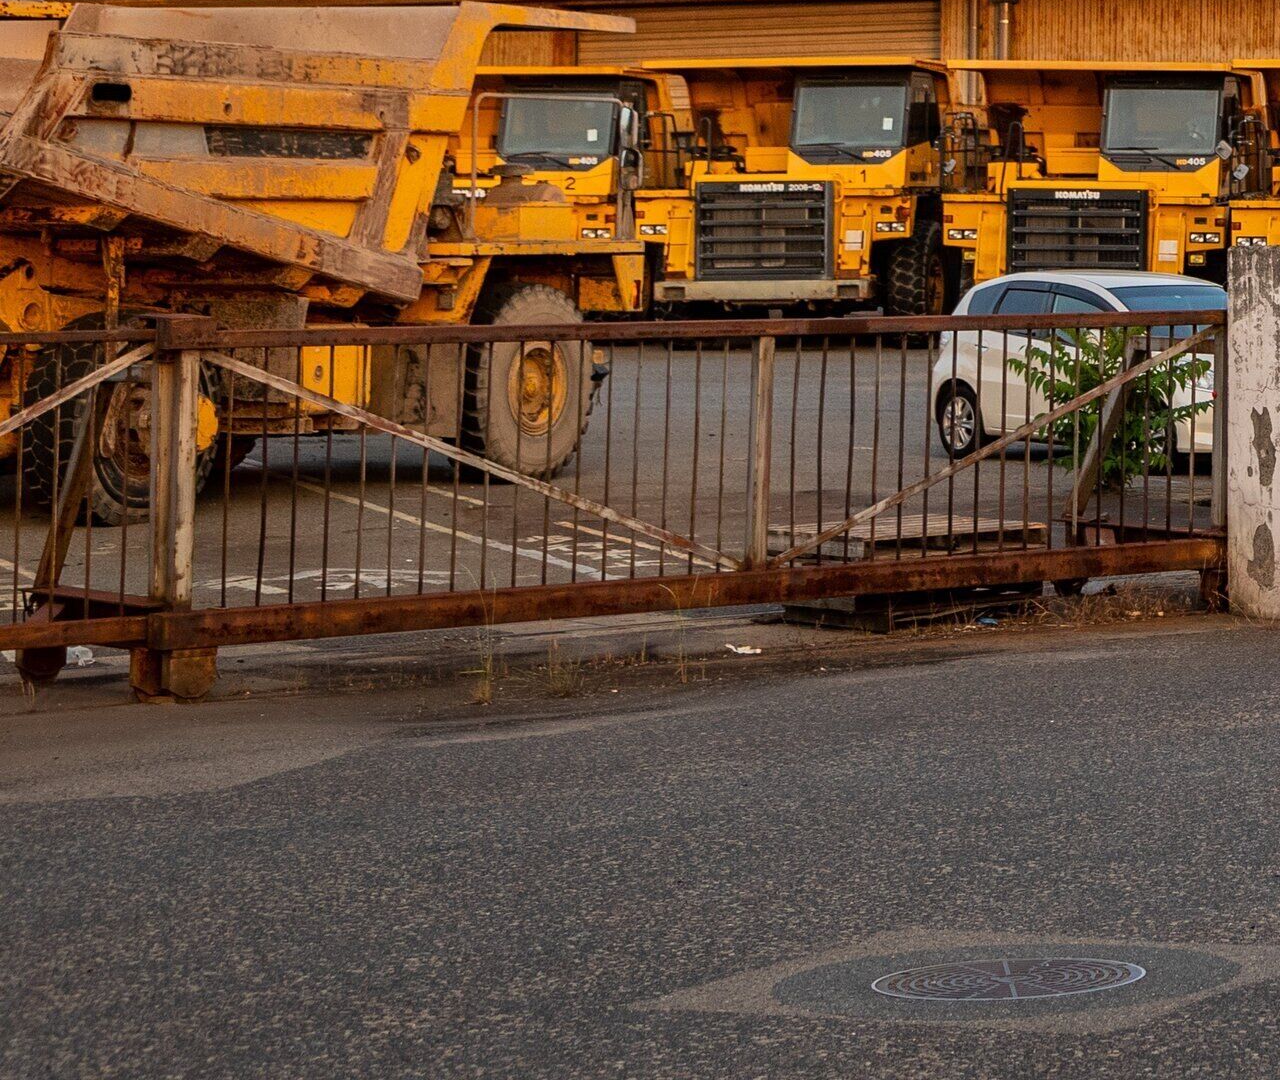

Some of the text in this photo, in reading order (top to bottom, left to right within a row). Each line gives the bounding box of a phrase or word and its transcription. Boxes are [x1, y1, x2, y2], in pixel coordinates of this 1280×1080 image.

[860, 170, 867, 183] 1
[565, 177, 575, 190] 2
[739, 183, 784, 192] KOMATSU
[1055, 190, 1100, 199] KOMATSU
